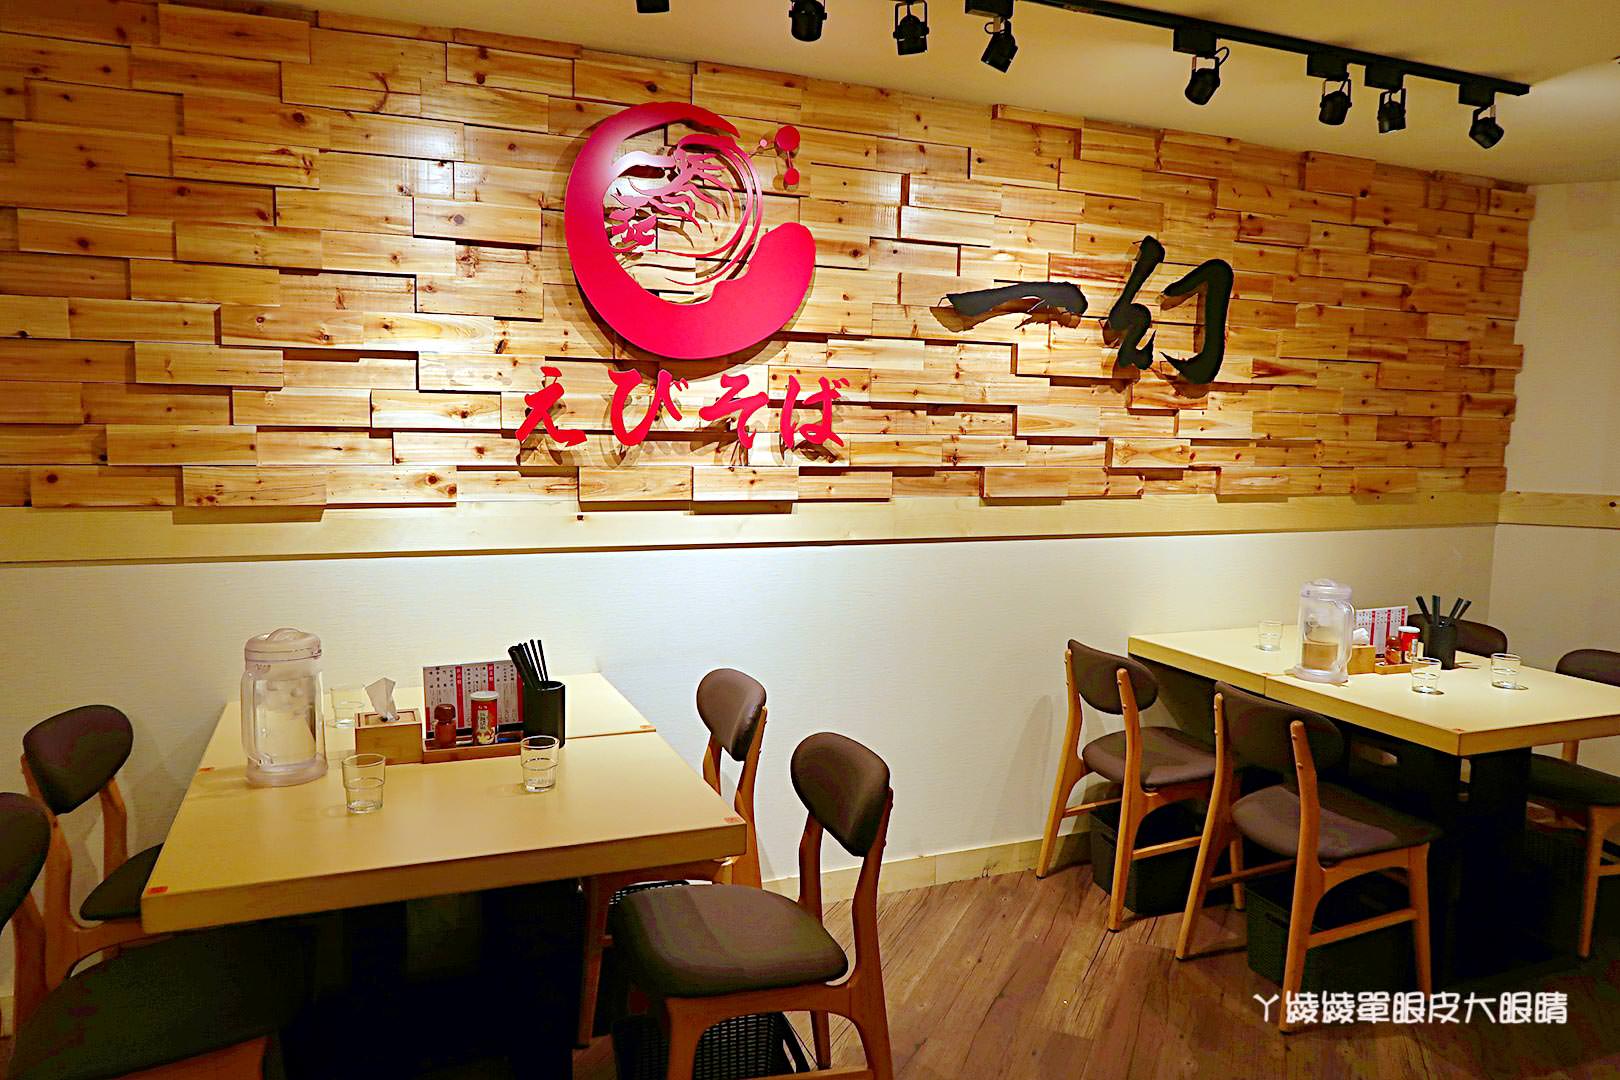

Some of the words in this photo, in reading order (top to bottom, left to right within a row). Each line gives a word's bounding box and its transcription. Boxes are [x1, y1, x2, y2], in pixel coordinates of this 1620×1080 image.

[945, 234, 1235, 385] 一幻
[515, 365, 850, 449] えびそば
